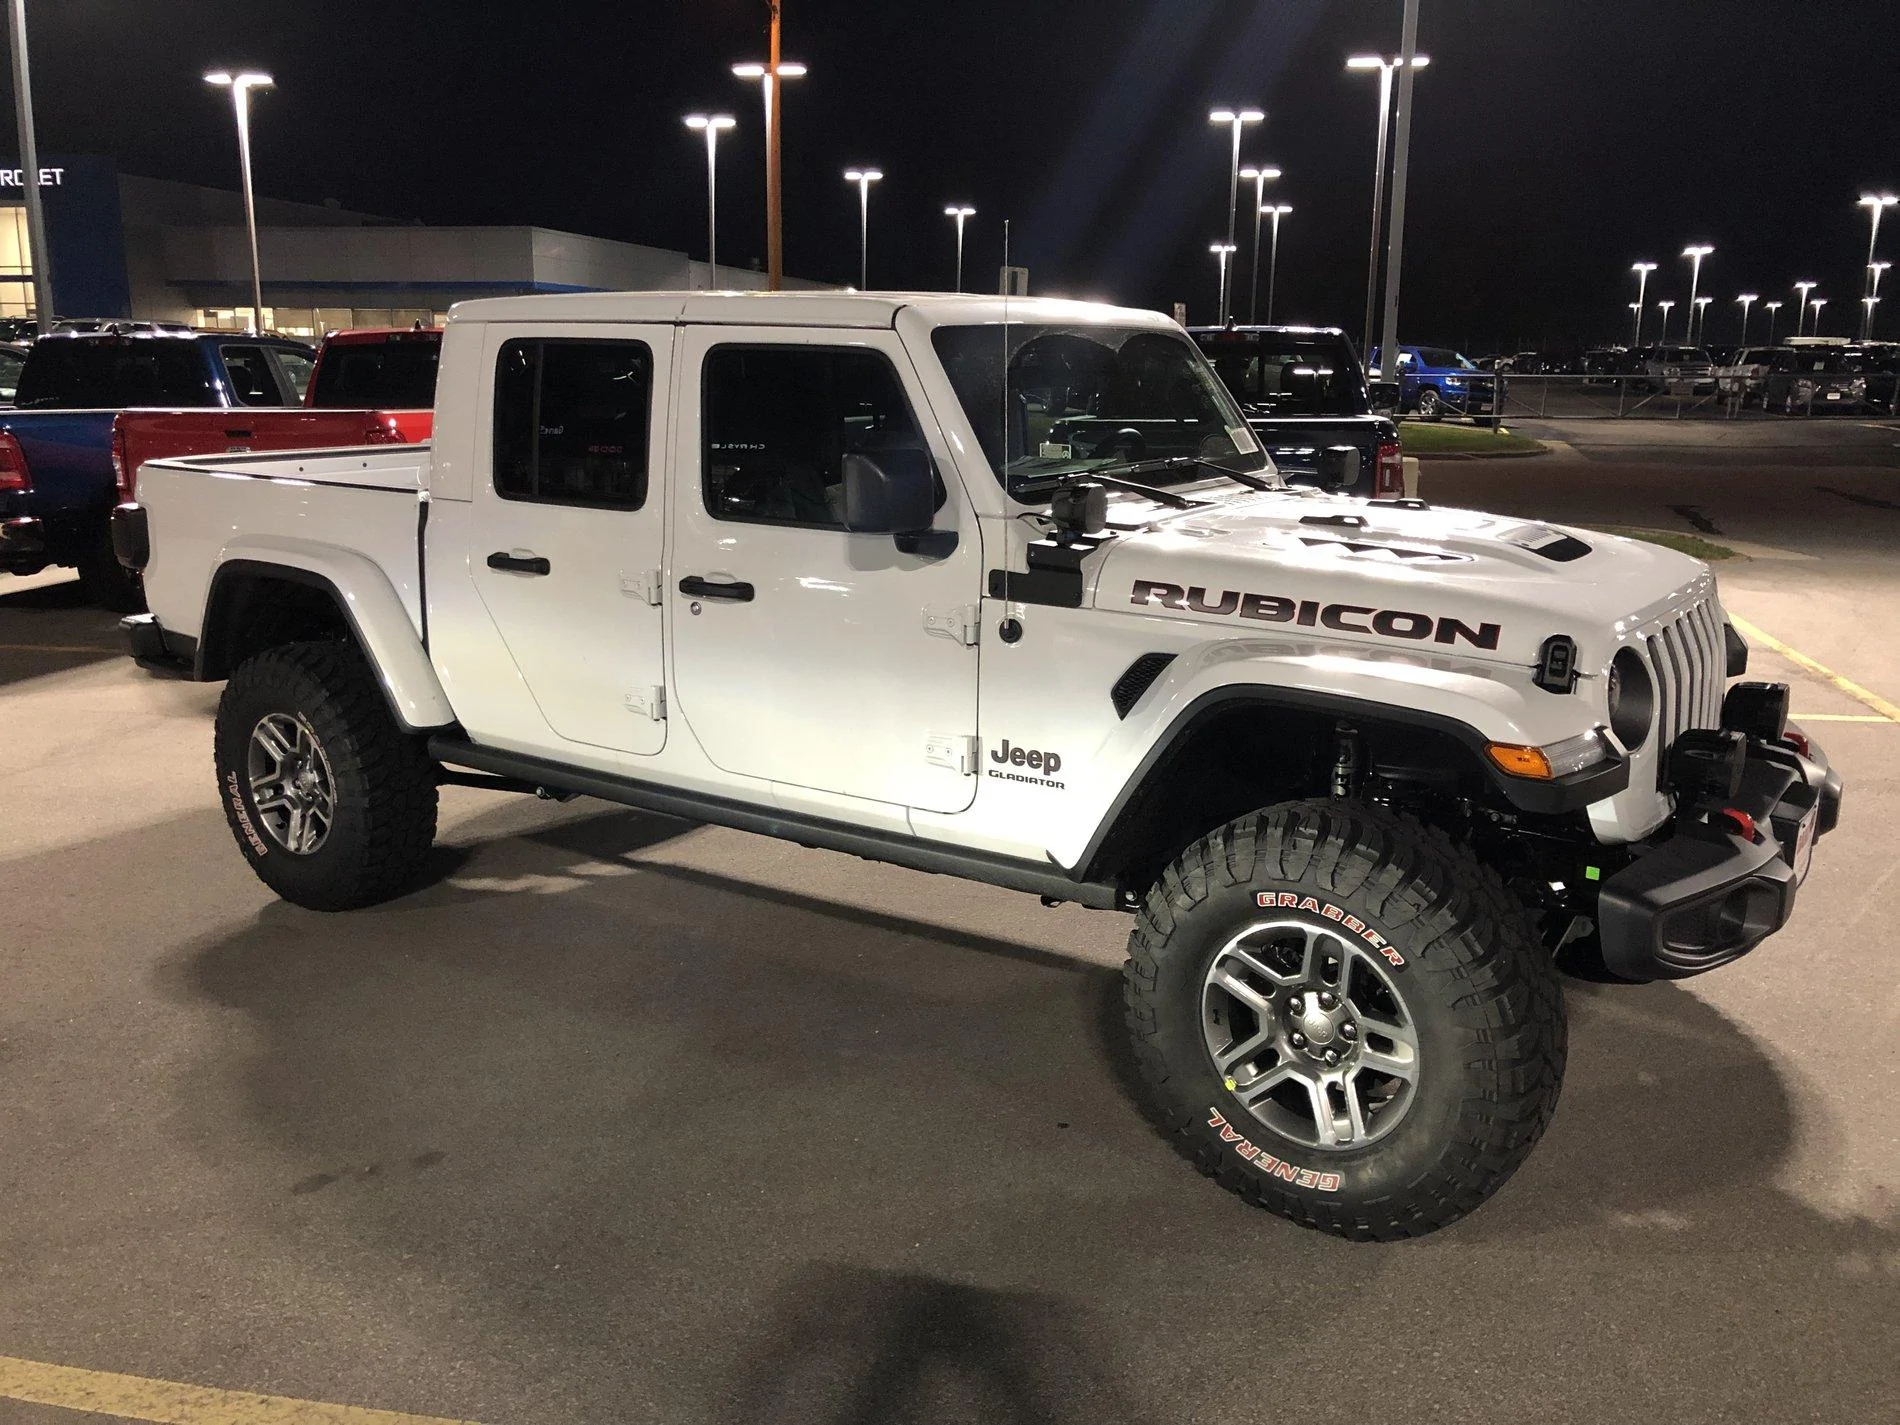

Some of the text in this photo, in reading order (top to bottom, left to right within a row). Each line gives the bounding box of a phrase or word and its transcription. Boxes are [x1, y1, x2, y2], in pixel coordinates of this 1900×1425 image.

[1130, 579, 1502, 650] RUBICON
[988, 769, 1065, 790] GLADIATOR
[990, 739, 1062, 776] Jeep
[1257, 892, 1405, 966] GRABBER
[1207, 1106, 1341, 1192] GENERAL
